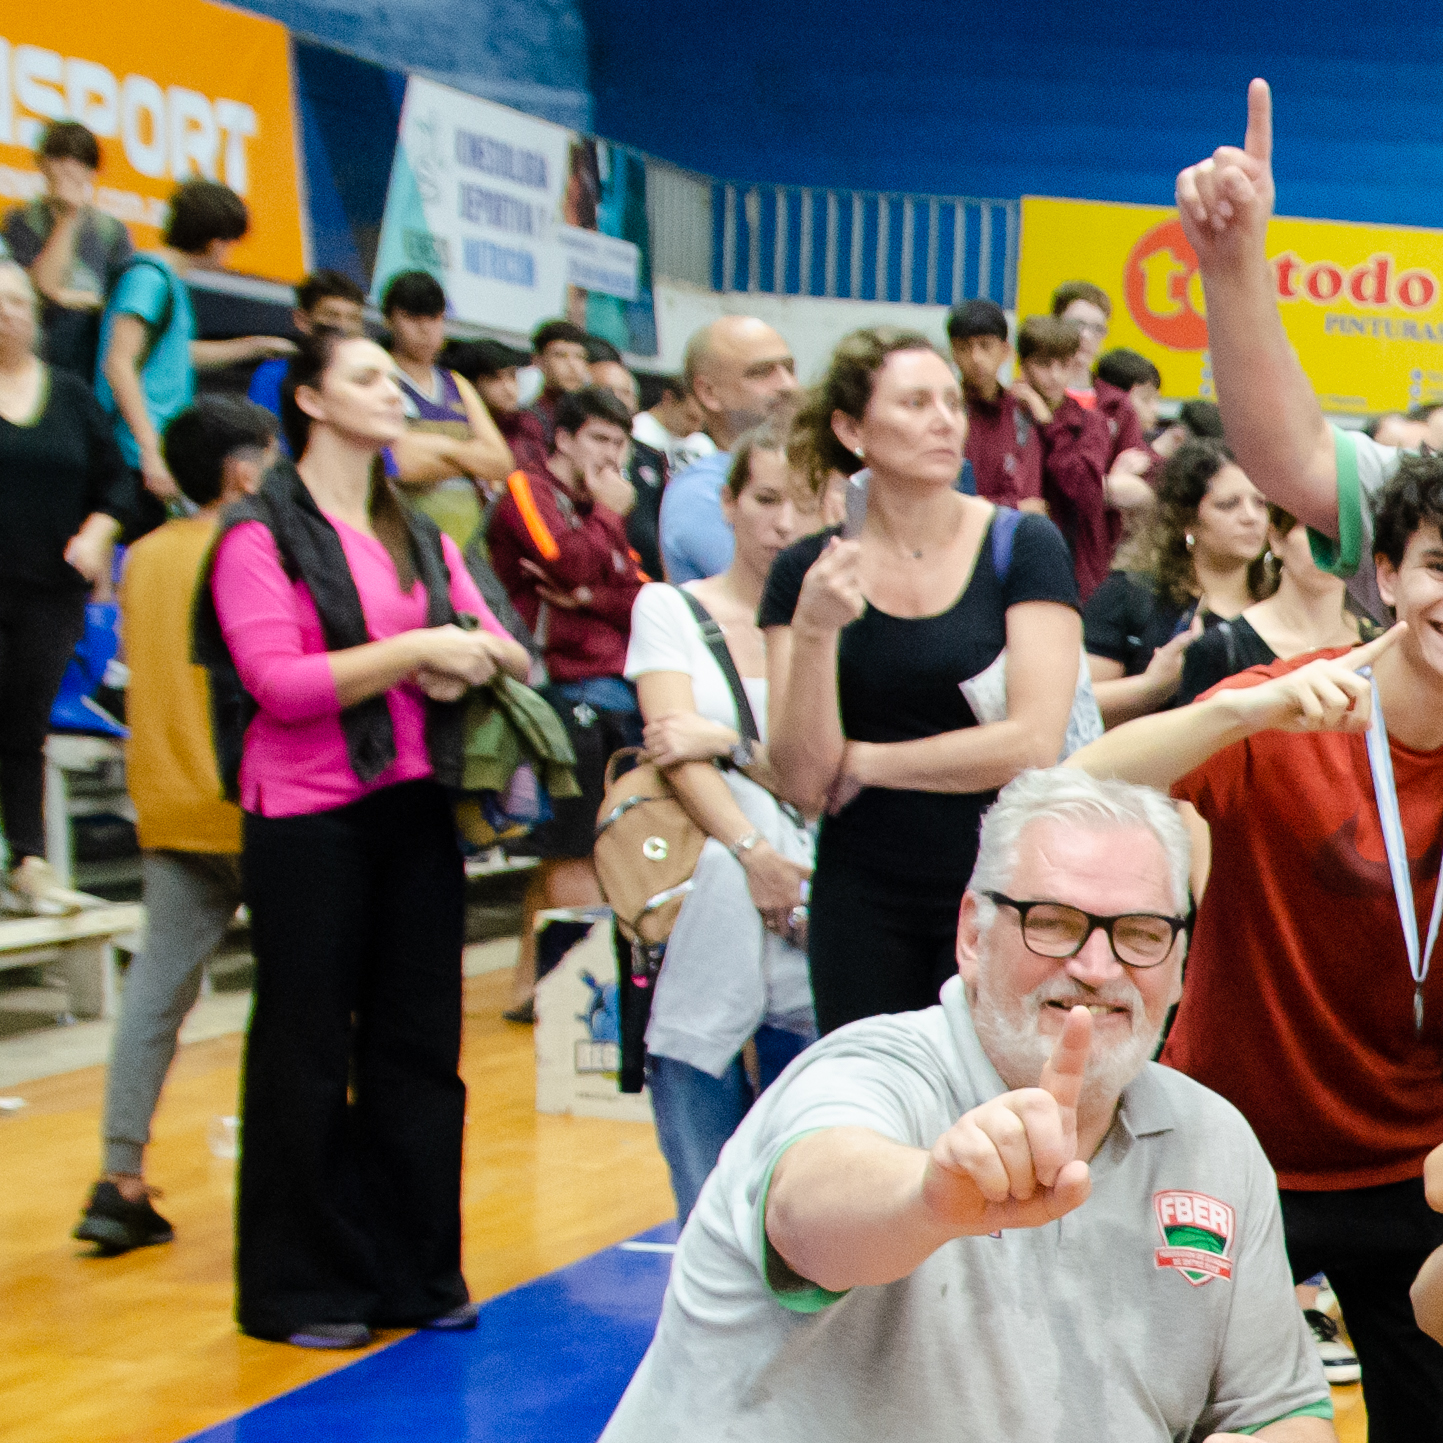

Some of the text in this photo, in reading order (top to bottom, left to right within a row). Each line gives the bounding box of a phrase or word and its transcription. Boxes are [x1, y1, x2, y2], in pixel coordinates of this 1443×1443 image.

[0, 36, 258, 196] SPORT
[1275, 257, 1436, 310] todo
[1160, 1195, 1229, 1238] FBER
